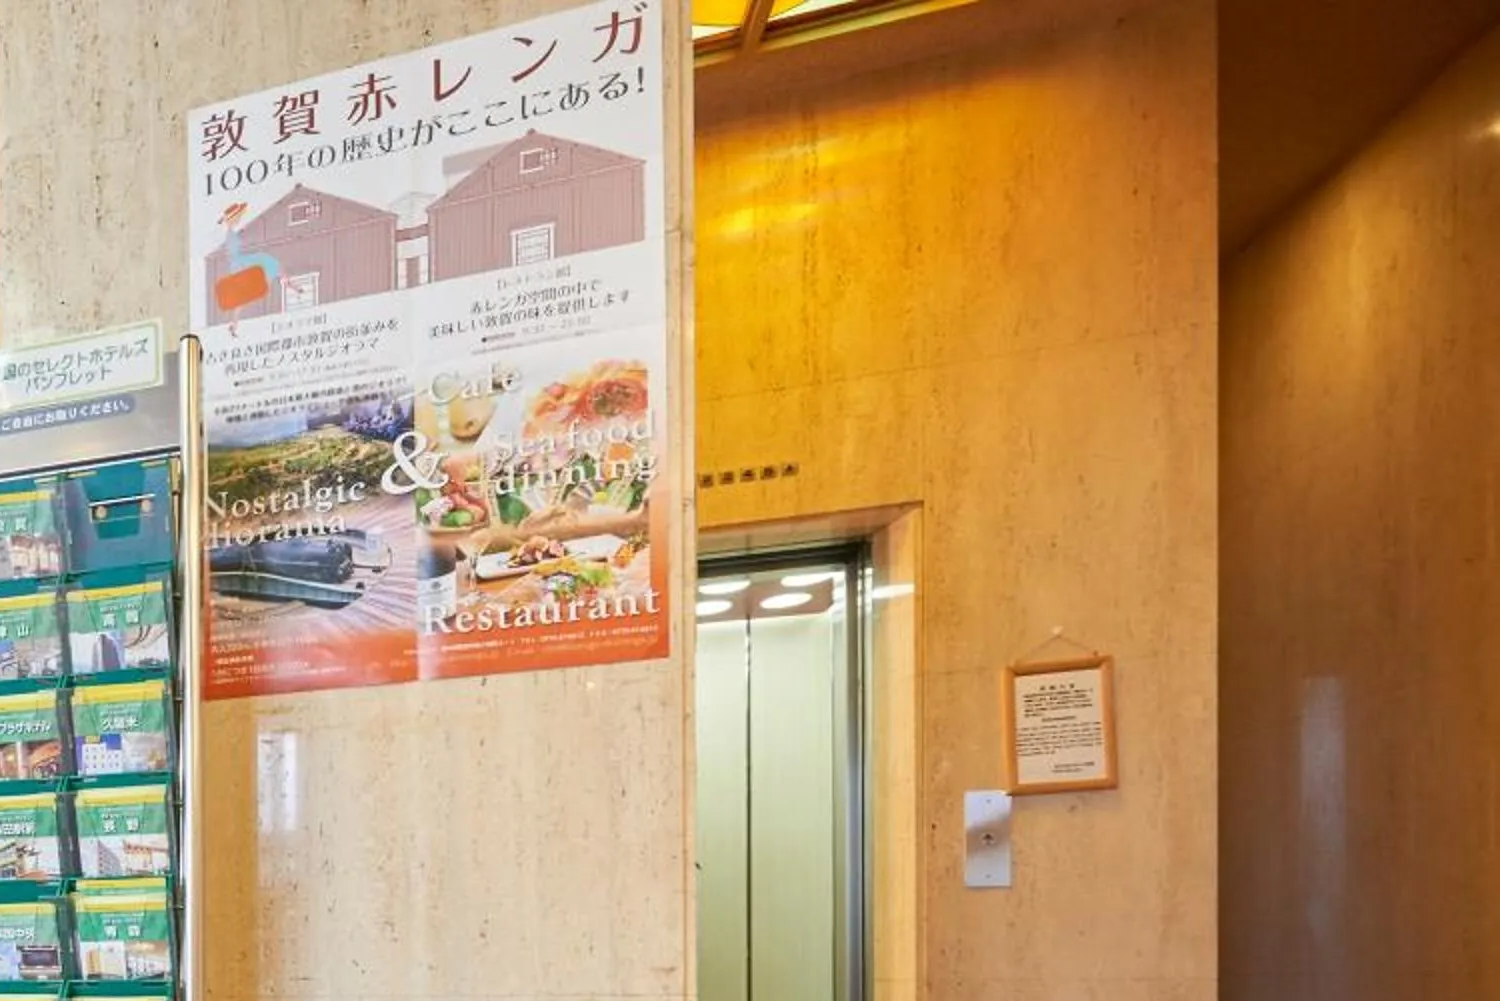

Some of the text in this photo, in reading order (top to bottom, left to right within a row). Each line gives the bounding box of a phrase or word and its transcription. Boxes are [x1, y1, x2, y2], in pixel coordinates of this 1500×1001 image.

[201, 1, 650, 163] 敦賀赤レンガ
[26, 365, 113, 392] パンフレット
[430, 362, 521, 404] Cafe
[381, 432, 448, 495] &
[205, 475, 366, 518] Nostalgic
[424, 587, 661, 636] Restaurant
